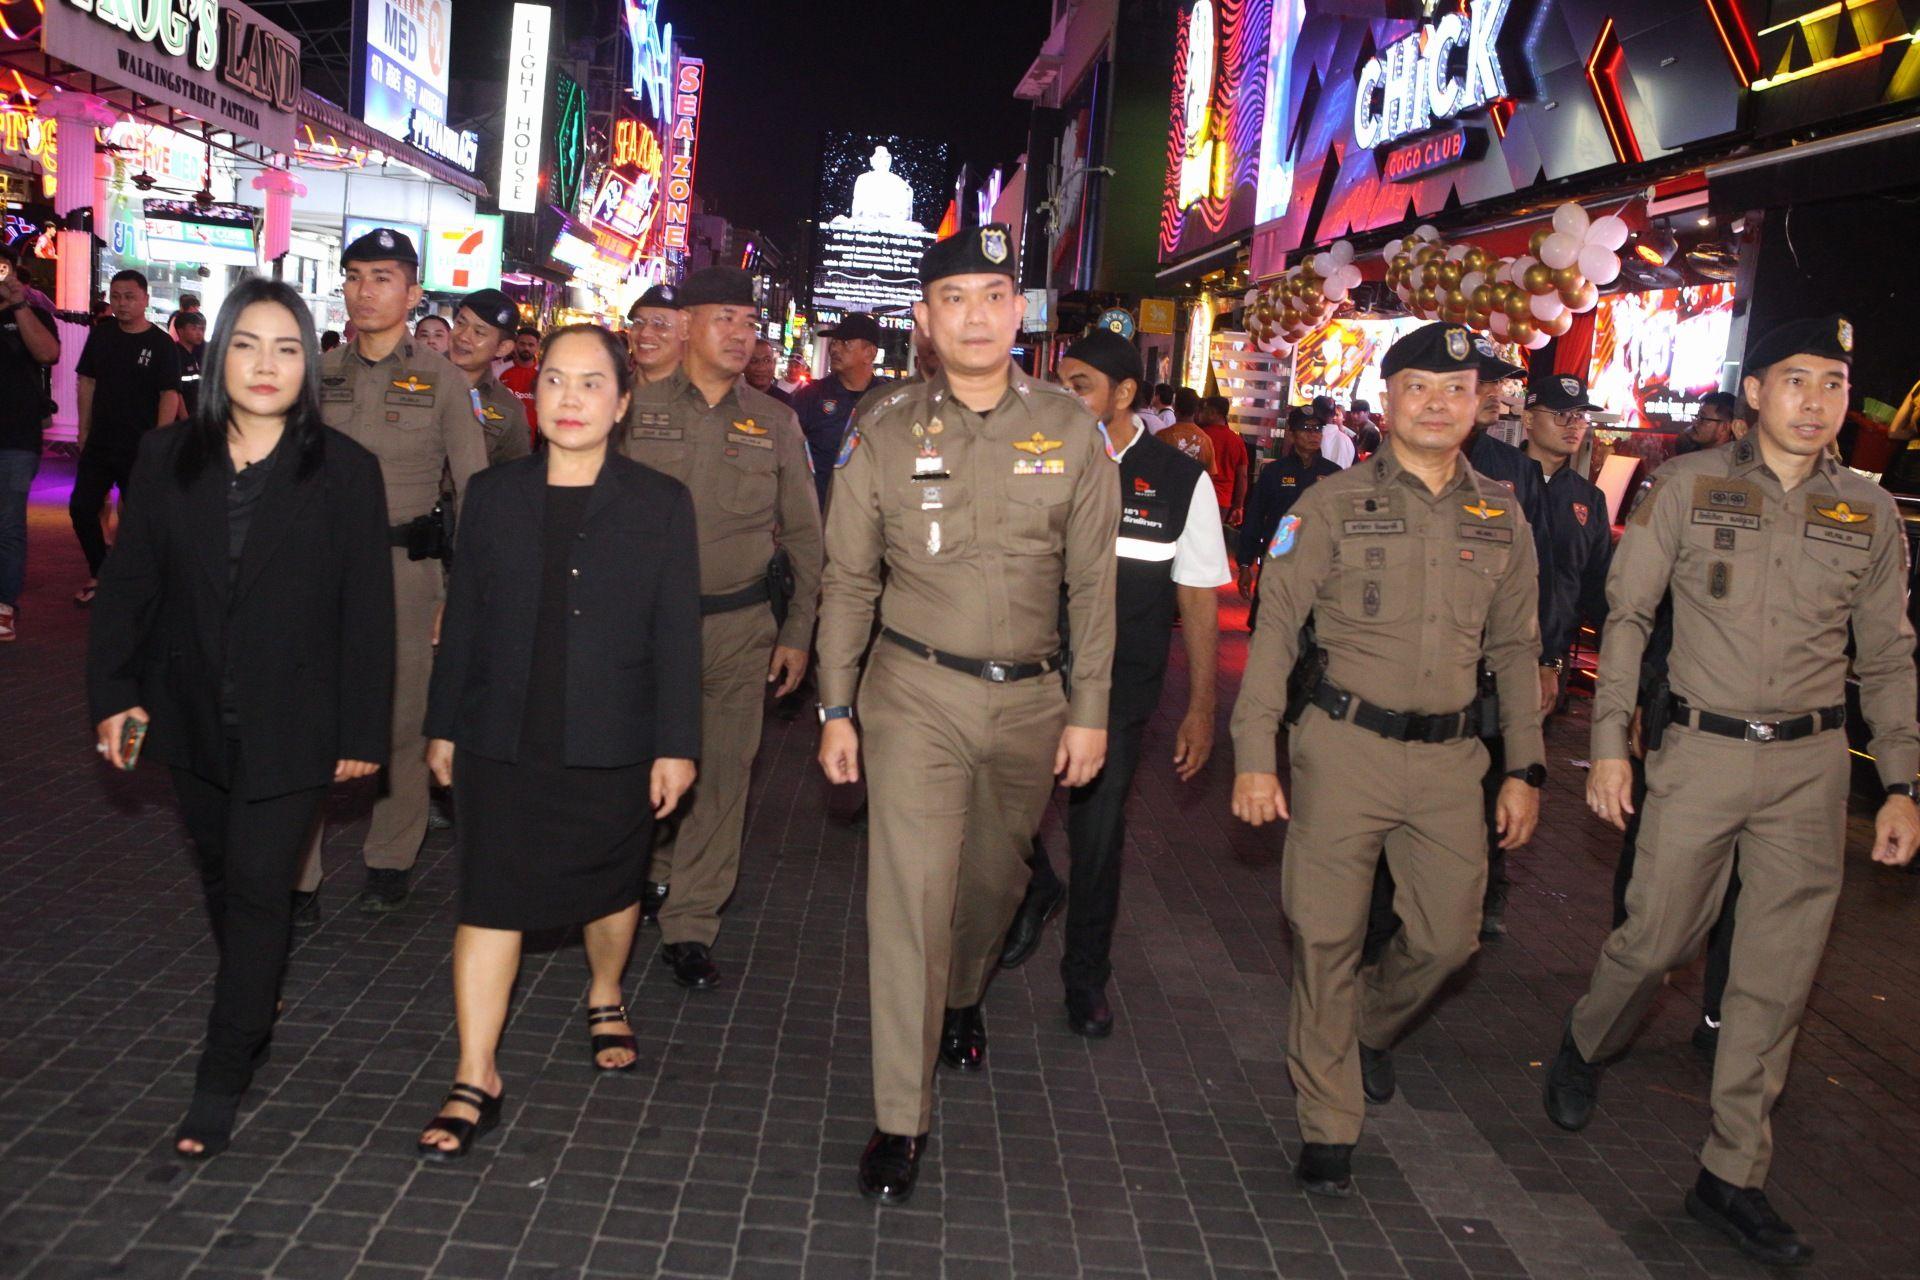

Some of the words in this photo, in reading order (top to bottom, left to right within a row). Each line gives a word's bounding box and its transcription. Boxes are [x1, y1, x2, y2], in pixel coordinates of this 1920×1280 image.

[225, 8, 299, 113] LAND
[384, 2, 418, 62] MED
[520, 19, 536, 104] LIGHT
[219, 96, 260, 131] PATTAYA
[674, 65, 701, 141] SEA
[513, 115, 531, 200] HOUSE
[1389, 150, 1421, 177] GOGO
[1424, 133, 1461, 165] CLUB
[664, 154, 691, 248] ZONE
